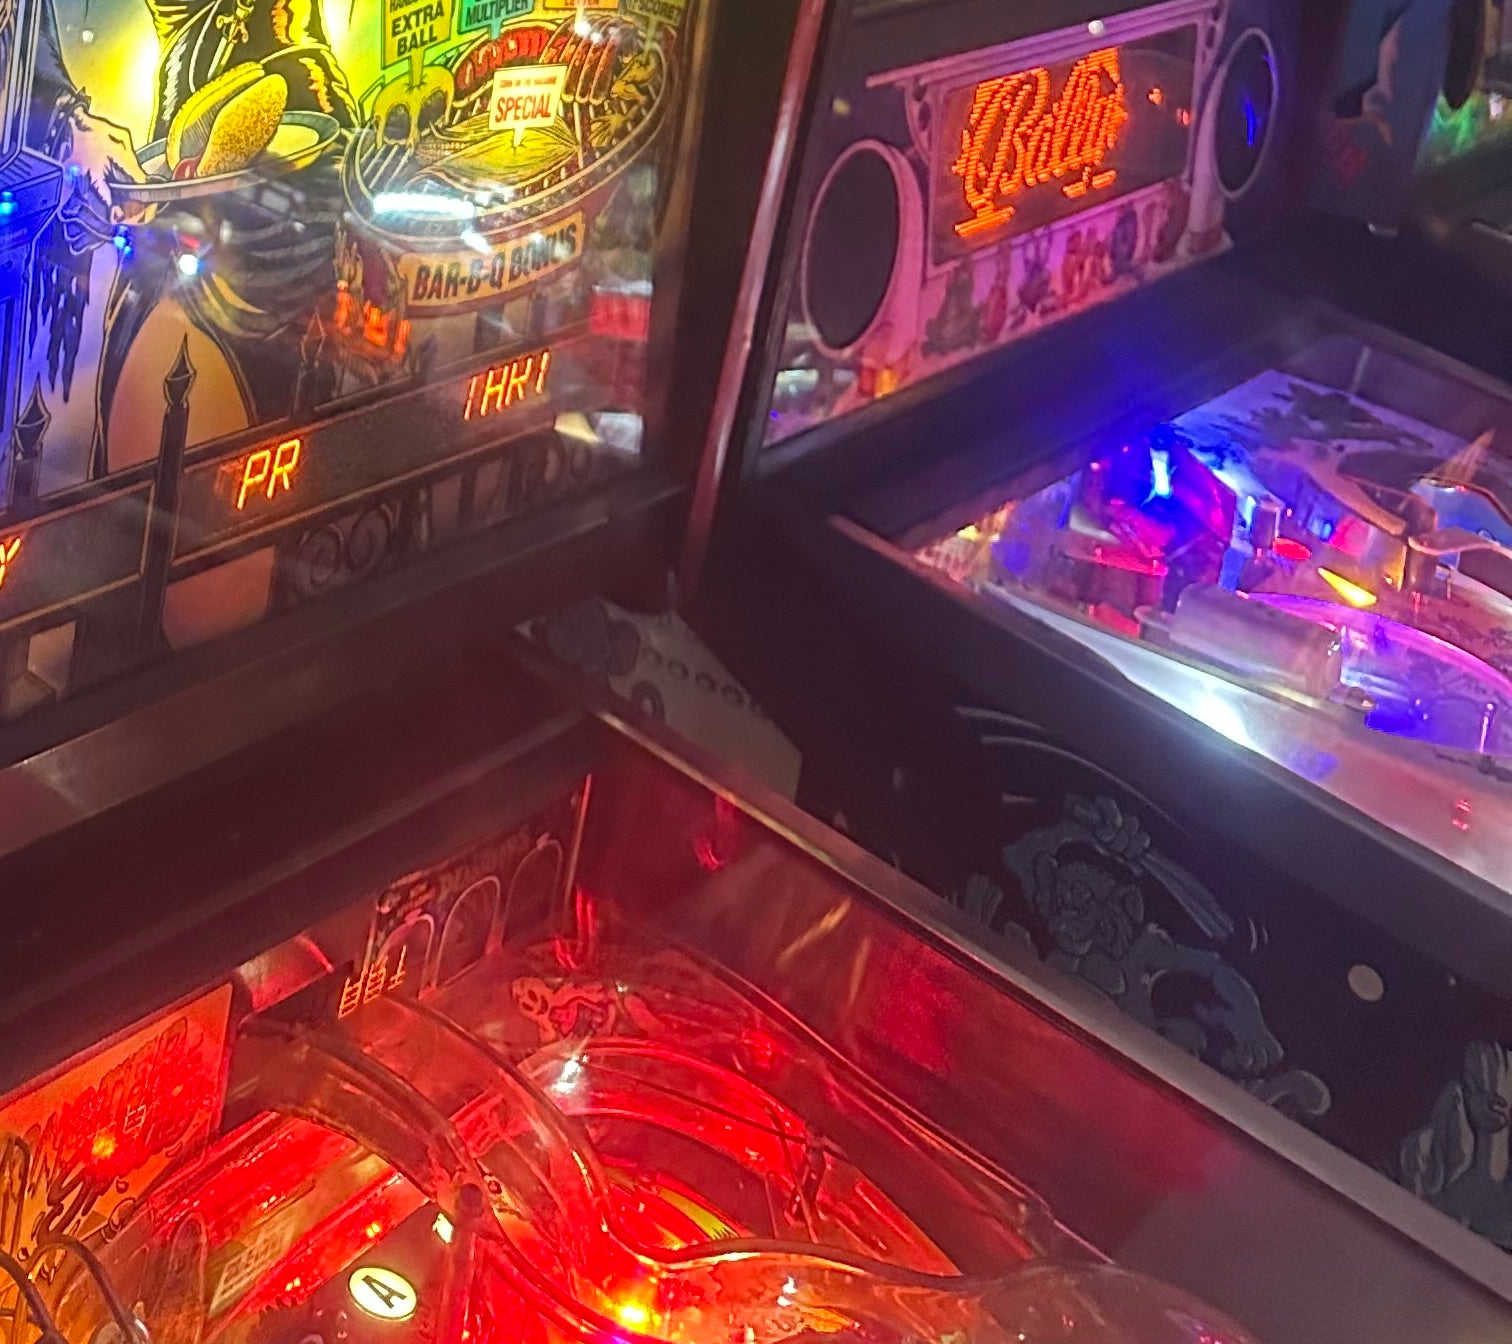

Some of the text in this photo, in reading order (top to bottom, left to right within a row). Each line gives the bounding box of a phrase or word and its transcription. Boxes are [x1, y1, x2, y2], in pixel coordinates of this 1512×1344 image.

[391, 0, 445, 38] EXTRA
[397, 23, 437, 57] BALL
[494, 92, 552, 123] SPECIAL
[360, 1273, 410, 1311] A
